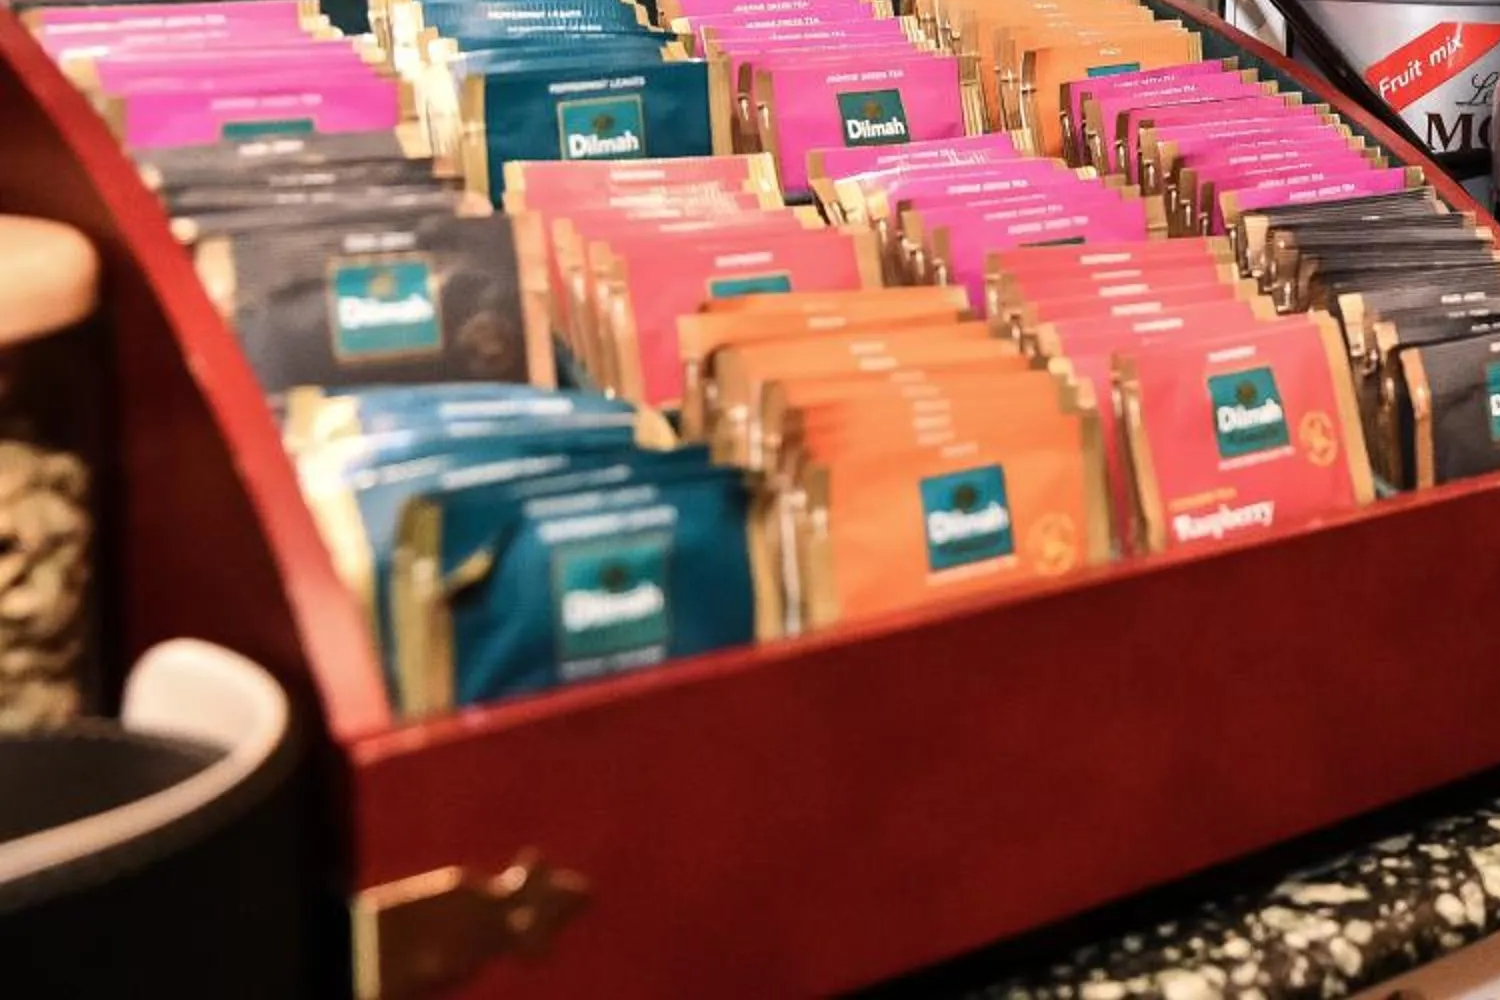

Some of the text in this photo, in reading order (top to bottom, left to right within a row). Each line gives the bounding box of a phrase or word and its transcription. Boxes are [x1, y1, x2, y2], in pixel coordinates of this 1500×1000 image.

[1379, 35, 1463, 99] Fruit mix
[847, 116, 905, 138] Dilmah
